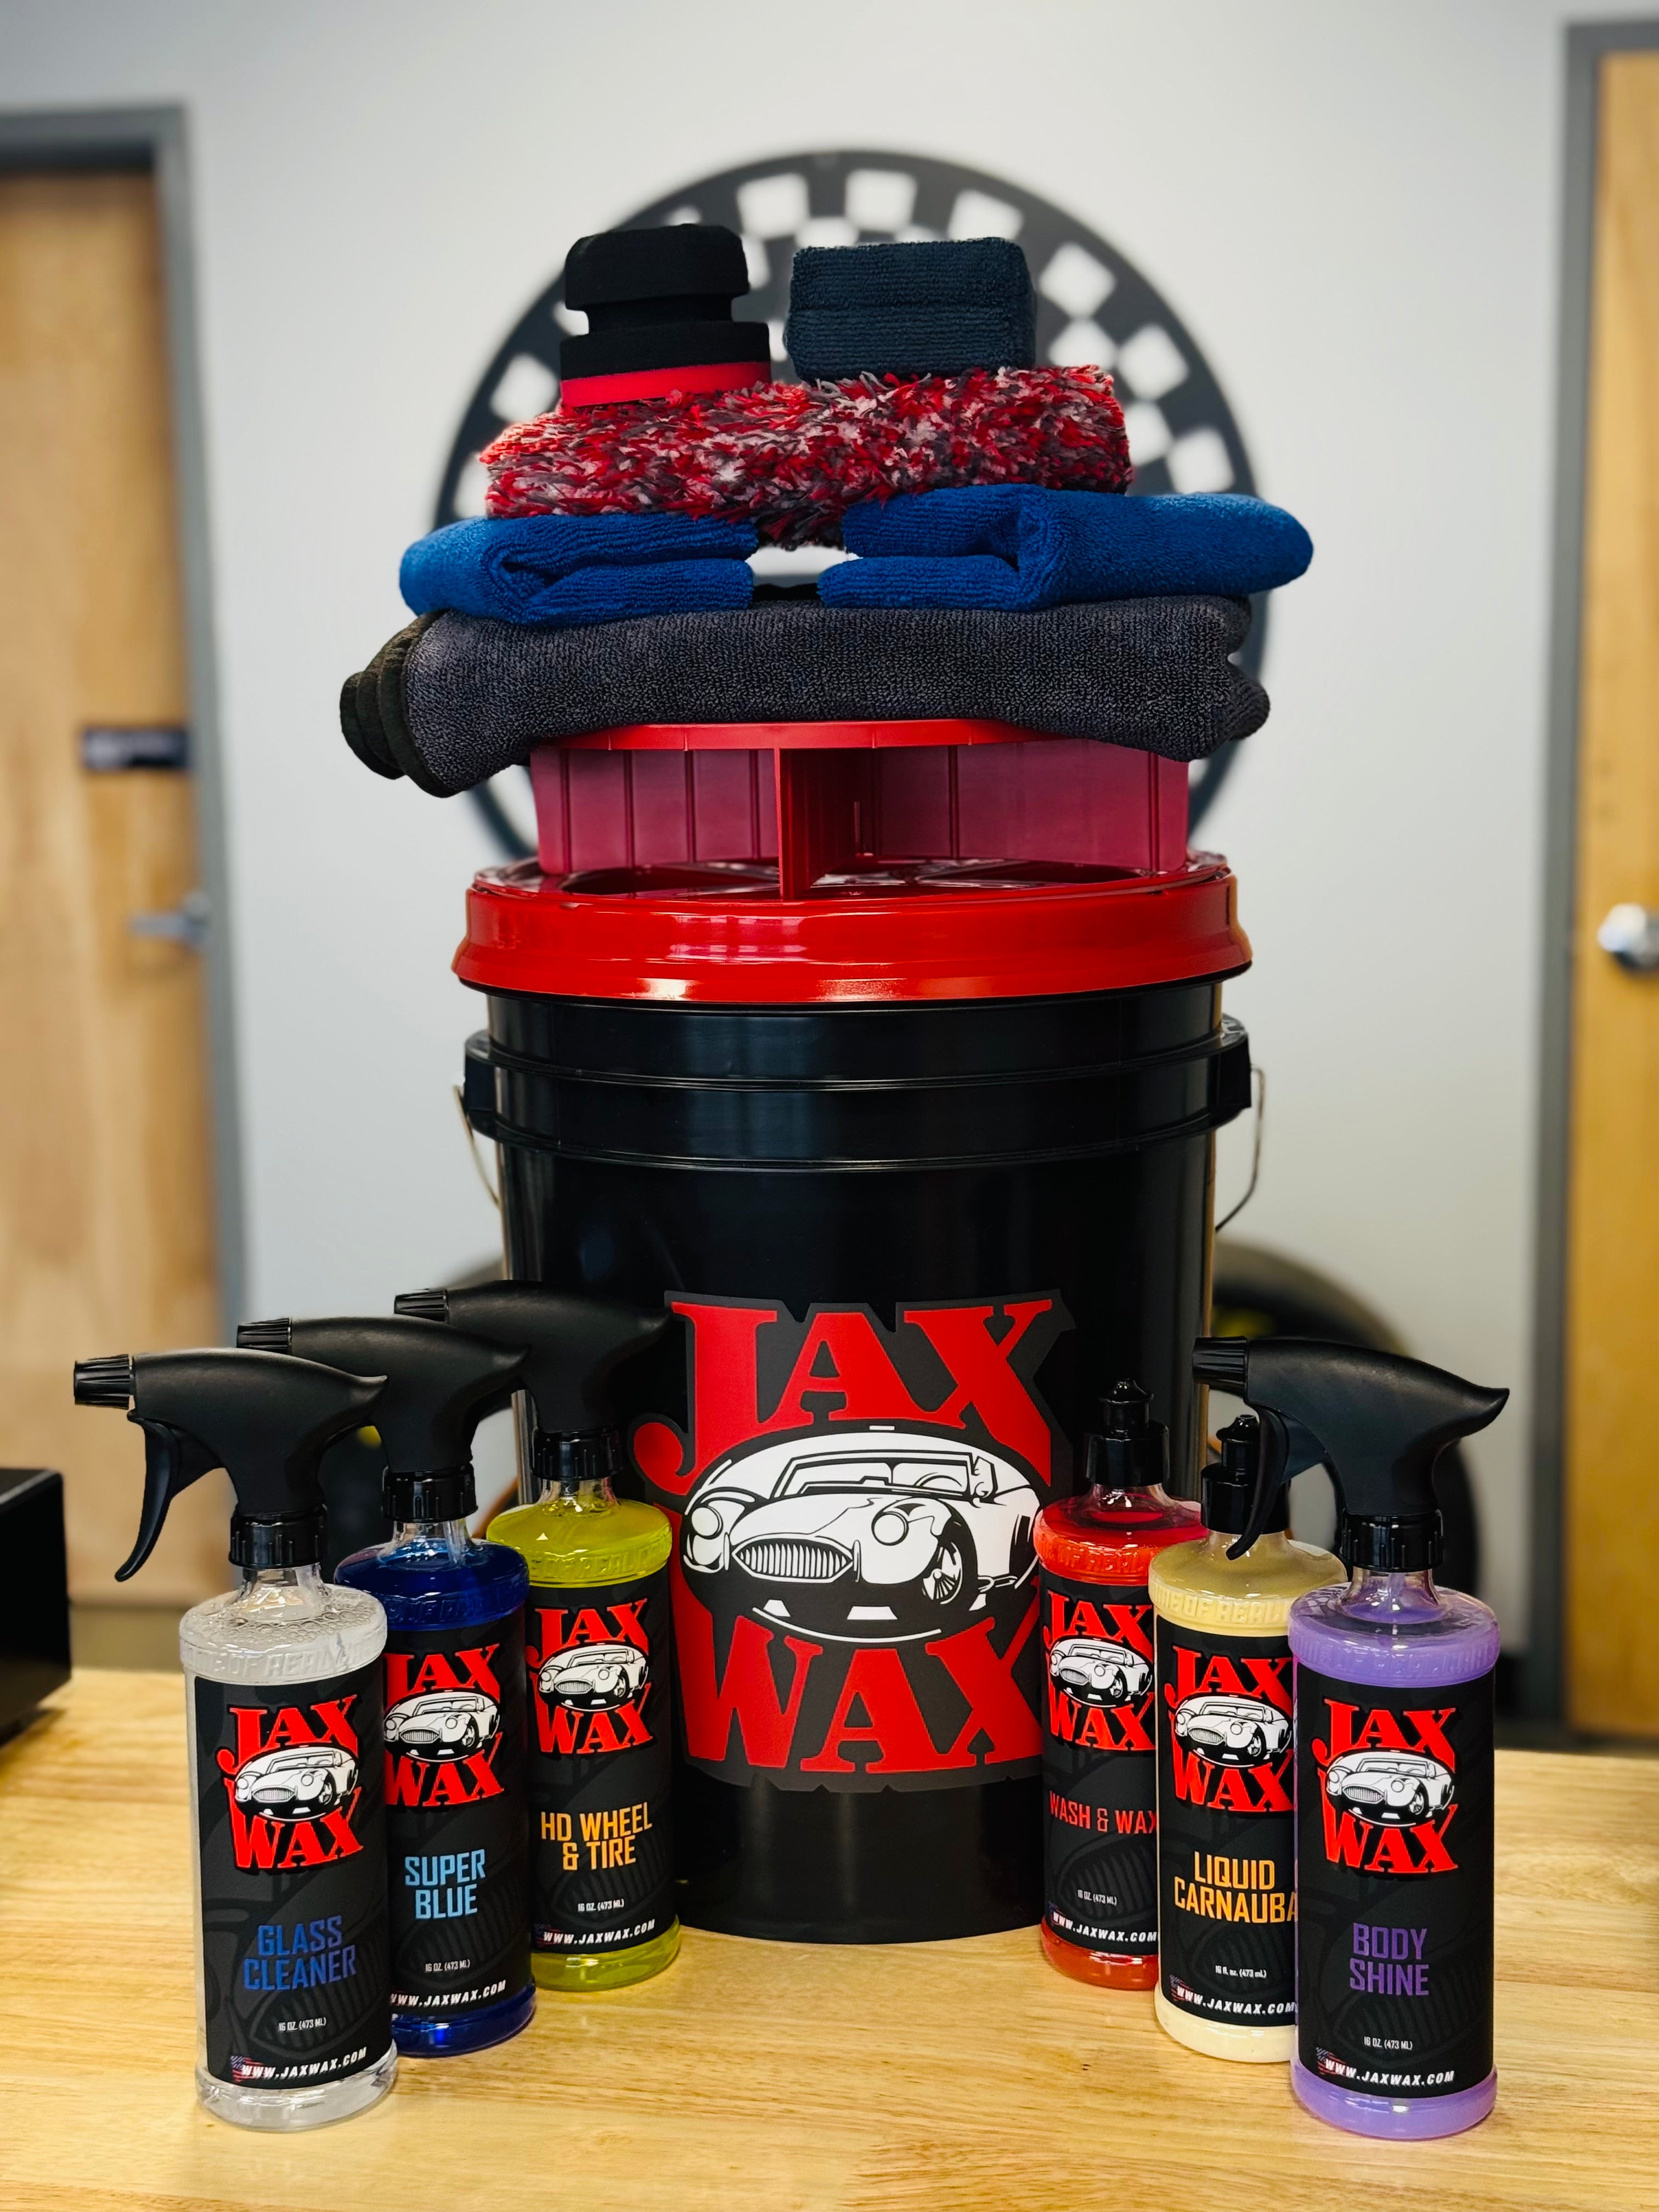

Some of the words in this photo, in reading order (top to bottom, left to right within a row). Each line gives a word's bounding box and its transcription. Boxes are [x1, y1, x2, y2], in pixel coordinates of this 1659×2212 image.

[633, 1299, 1052, 1494] JAX
[526, 1598, 649, 1668] JAX
[653, 1503, 1042, 1774] WAX
[1043, 1590, 1153, 1662] JAX
[1045, 1649, 1155, 1751] WAX
[1164, 1645, 1293, 1716] JAX
[217, 1695, 359, 1774] JAX
[529, 1672, 653, 1754] WAX
[1312, 1699, 1456, 1774] JAX
[385, 1732, 504, 1807] WAX
[1169, 1710, 1294, 1812] WAX
[224, 1778, 364, 1869] WAX
[541, 1811, 572, 1842] HD
[579, 1802, 653, 1842] WHEEL
[1049, 1791, 1091, 1830] WASH
[1097, 1807, 1109, 1832] &
[1318, 1767, 1458, 1873] WAX
[404, 1849, 486, 1886] SUPER
[562, 1842, 579, 1871] &
[586, 1835, 636, 1870] TIRE
[1194, 1850, 1275, 1891] LIQUID
[415, 1883, 478, 1920] BLUE
[257, 1915, 343, 1956] GLASS
[543, 1919, 655, 1945] WWW.JAXWAX.COM
[1052, 1910, 1157, 1943] WWW.JAXWAX.COM
[1353, 1922, 1427, 1960] BODY
[243, 1944, 357, 1991] CLEANER
[1349, 1957, 1430, 1996] SHINE
[1177, 1985, 1296, 2015] WWW.JAXWAX.COM
[241, 2047, 367, 2079] WWW.JAXWAX.COM
[1325, 2058, 1455, 2087] WWW.JAXWAX.COM
